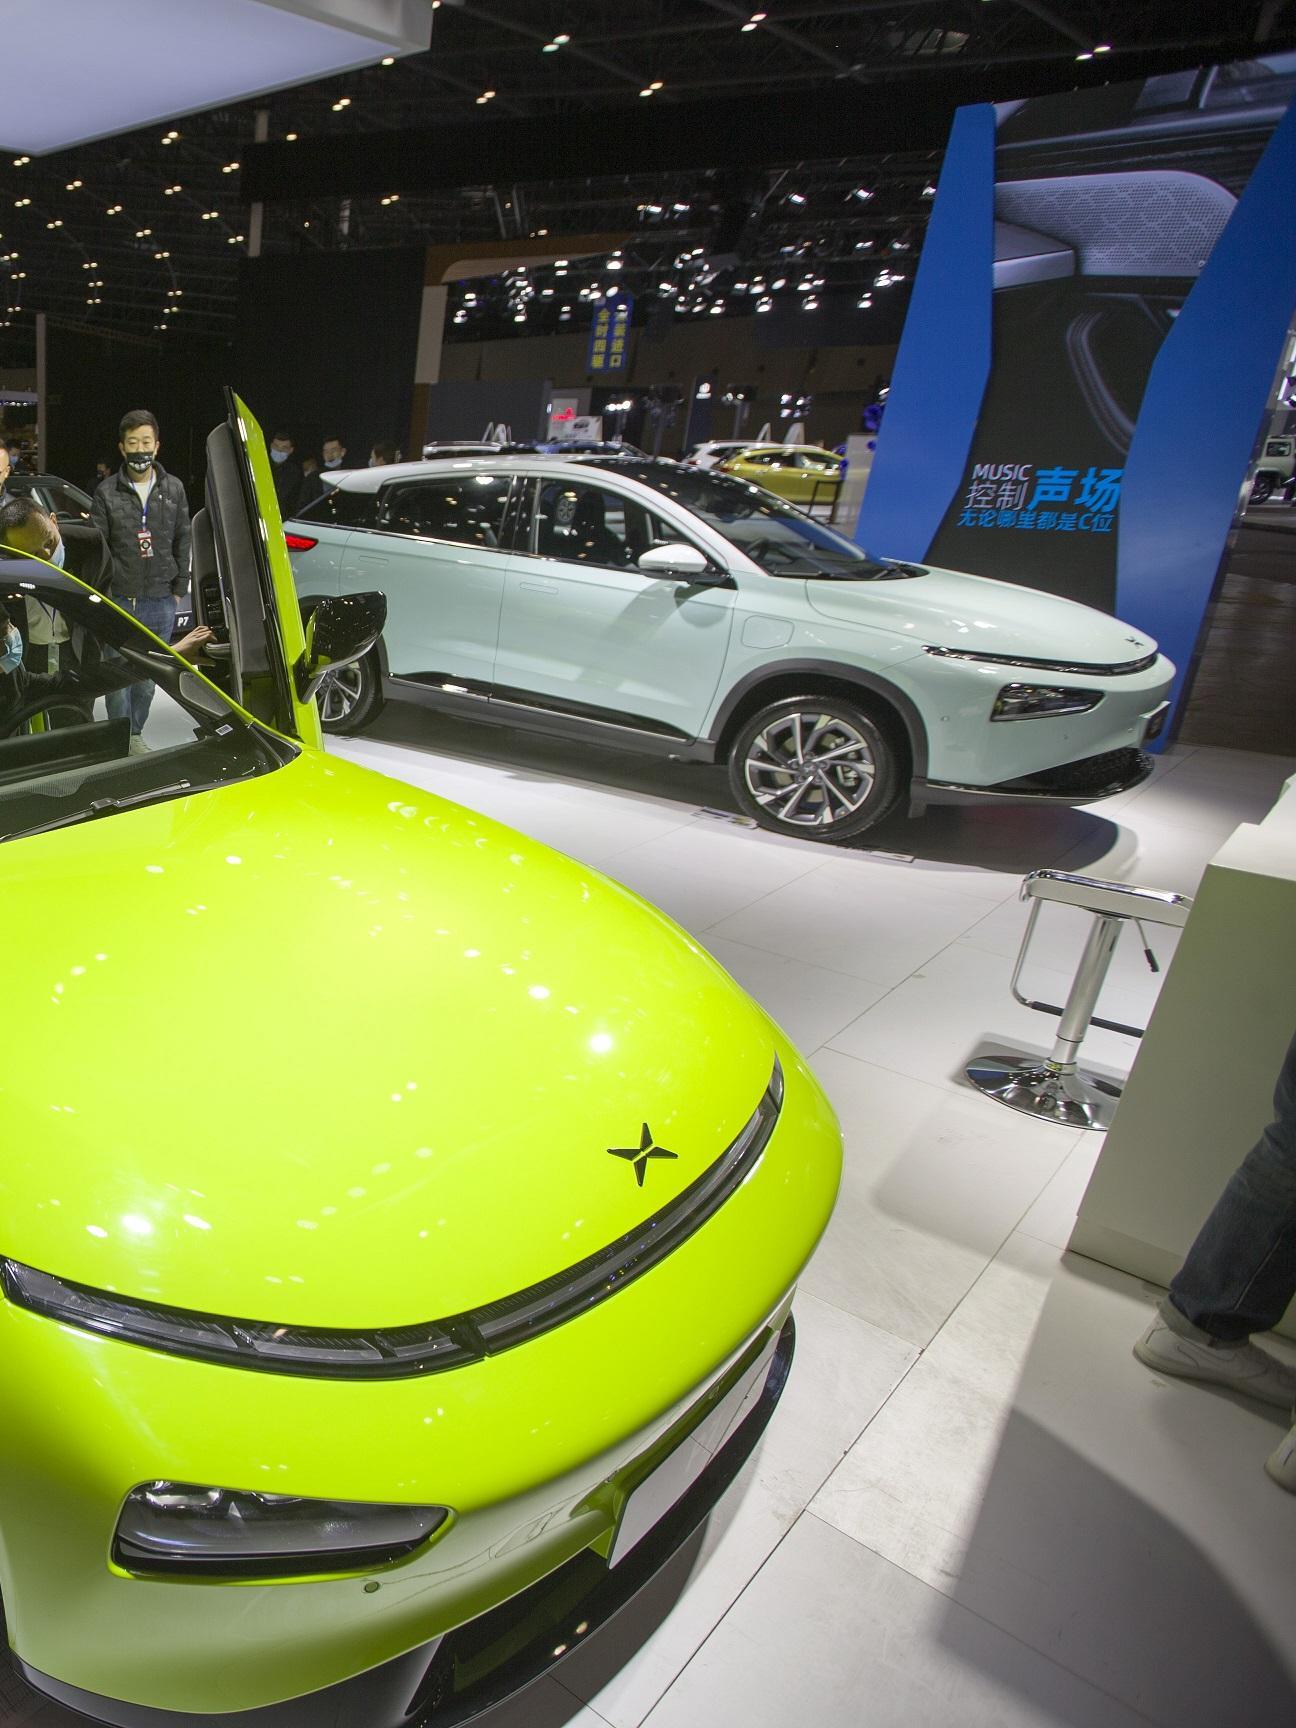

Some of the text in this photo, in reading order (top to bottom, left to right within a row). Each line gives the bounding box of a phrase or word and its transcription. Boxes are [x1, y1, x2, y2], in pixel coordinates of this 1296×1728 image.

[971, 463, 1033, 482] MUSIC
[964, 465, 1125, 513] 控制 声场
[177, 616, 189, 627] P7
